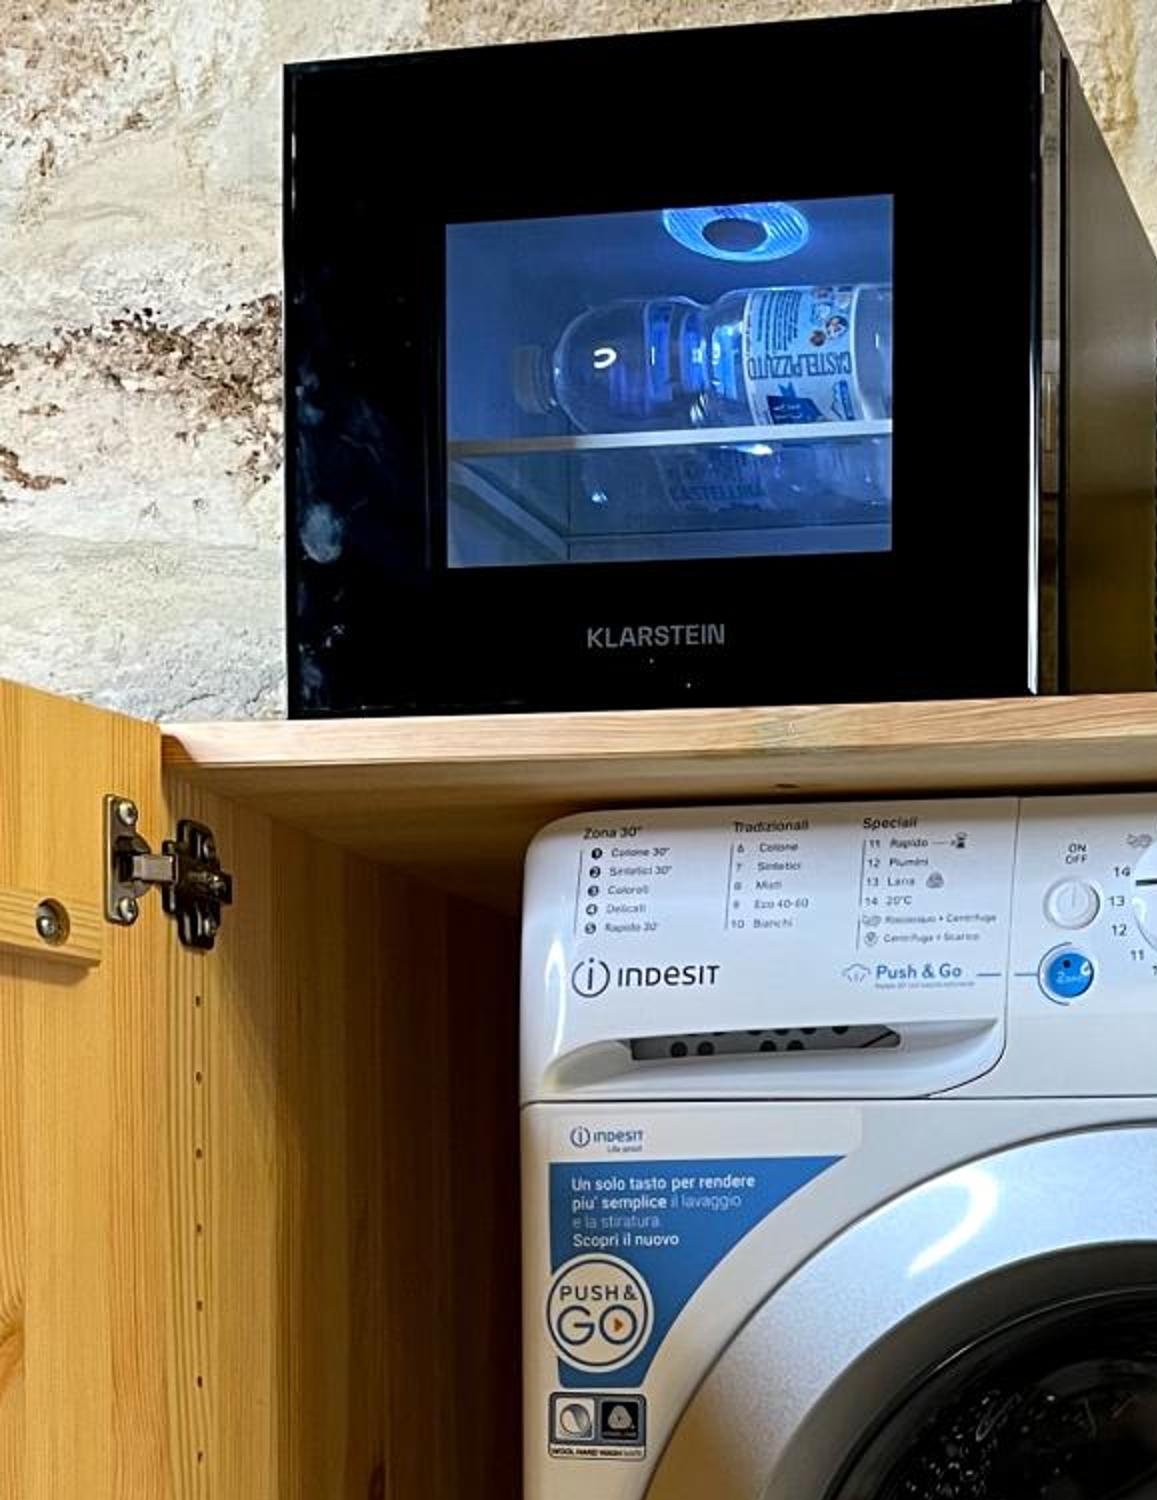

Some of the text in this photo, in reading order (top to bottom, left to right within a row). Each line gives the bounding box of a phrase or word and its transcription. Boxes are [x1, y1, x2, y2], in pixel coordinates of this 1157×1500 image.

[747, 352, 852, 380] CASTELPIZZUTO
[587, 624, 725, 648] KLARSTEIN
[734, 820, 809, 832] Tradizionali
[863, 816, 918, 830] Speciali
[584, 828, 617, 839] Zona
[760, 843, 799, 853] Cotone
[869, 840, 881, 848] 11
[1069, 843, 1087, 853] ON
[611, 848, 650, 858] Cotone
[868, 858, 880, 868] 12
[1065, 854, 1088, 864] OFF
[1114, 867, 1131, 877] 14
[867, 877, 915, 887] 13 Lana
[1108, 896, 1125, 907] 13
[1111, 925, 1127, 936] 12
[1130, 950, 1144, 960] 11
[876, 963, 962, 979] Push & Go
[571, 1175, 755, 1192] Un solo tasto per rendere
[602, 1195, 667, 1211] semplice
[671, 1195, 678, 1208] il
[681, 1194, 742, 1210] lavaggio
[573, 1215, 660, 1229] e la stiratura
[573, 1233, 679, 1249] Scopri il nuovo
[557, 1304, 637, 1345] GO
